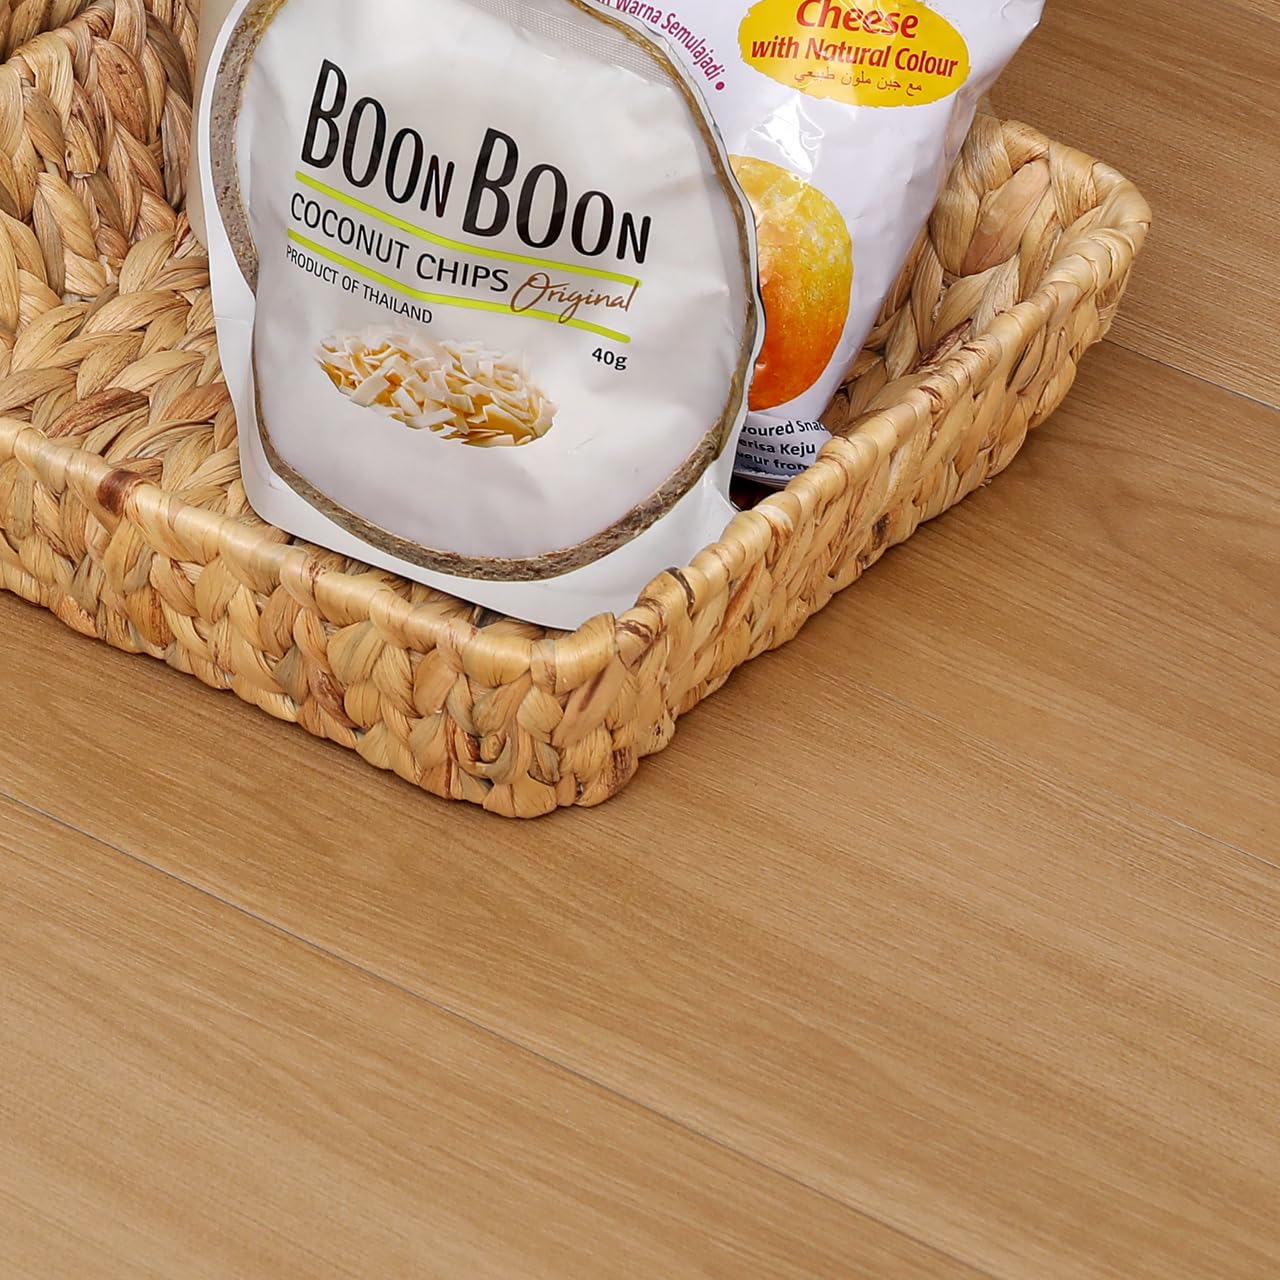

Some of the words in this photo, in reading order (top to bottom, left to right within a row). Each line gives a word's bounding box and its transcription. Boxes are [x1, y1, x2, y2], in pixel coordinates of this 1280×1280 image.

[660, 12, 726, 81] Semulajadi
[751, 35, 800, 60] with
[805, 37, 893, 68] Natural
[894, 47, 959, 77] Colour
[301, 58, 455, 219] BOON
[461, 127, 651, 265] BOON
[286, 245, 339, 285] PRODUCT
[341, 275, 360, 294] OF
[362, 284, 433, 324] THAILAND
[290, 192, 410, 270] COCONUT
[416, 253, 510, 292] CHIPS
[509, 272, 640, 324] Original
[591, 347, 628, 370] 40g
[780, 442, 816, 458] Keju
